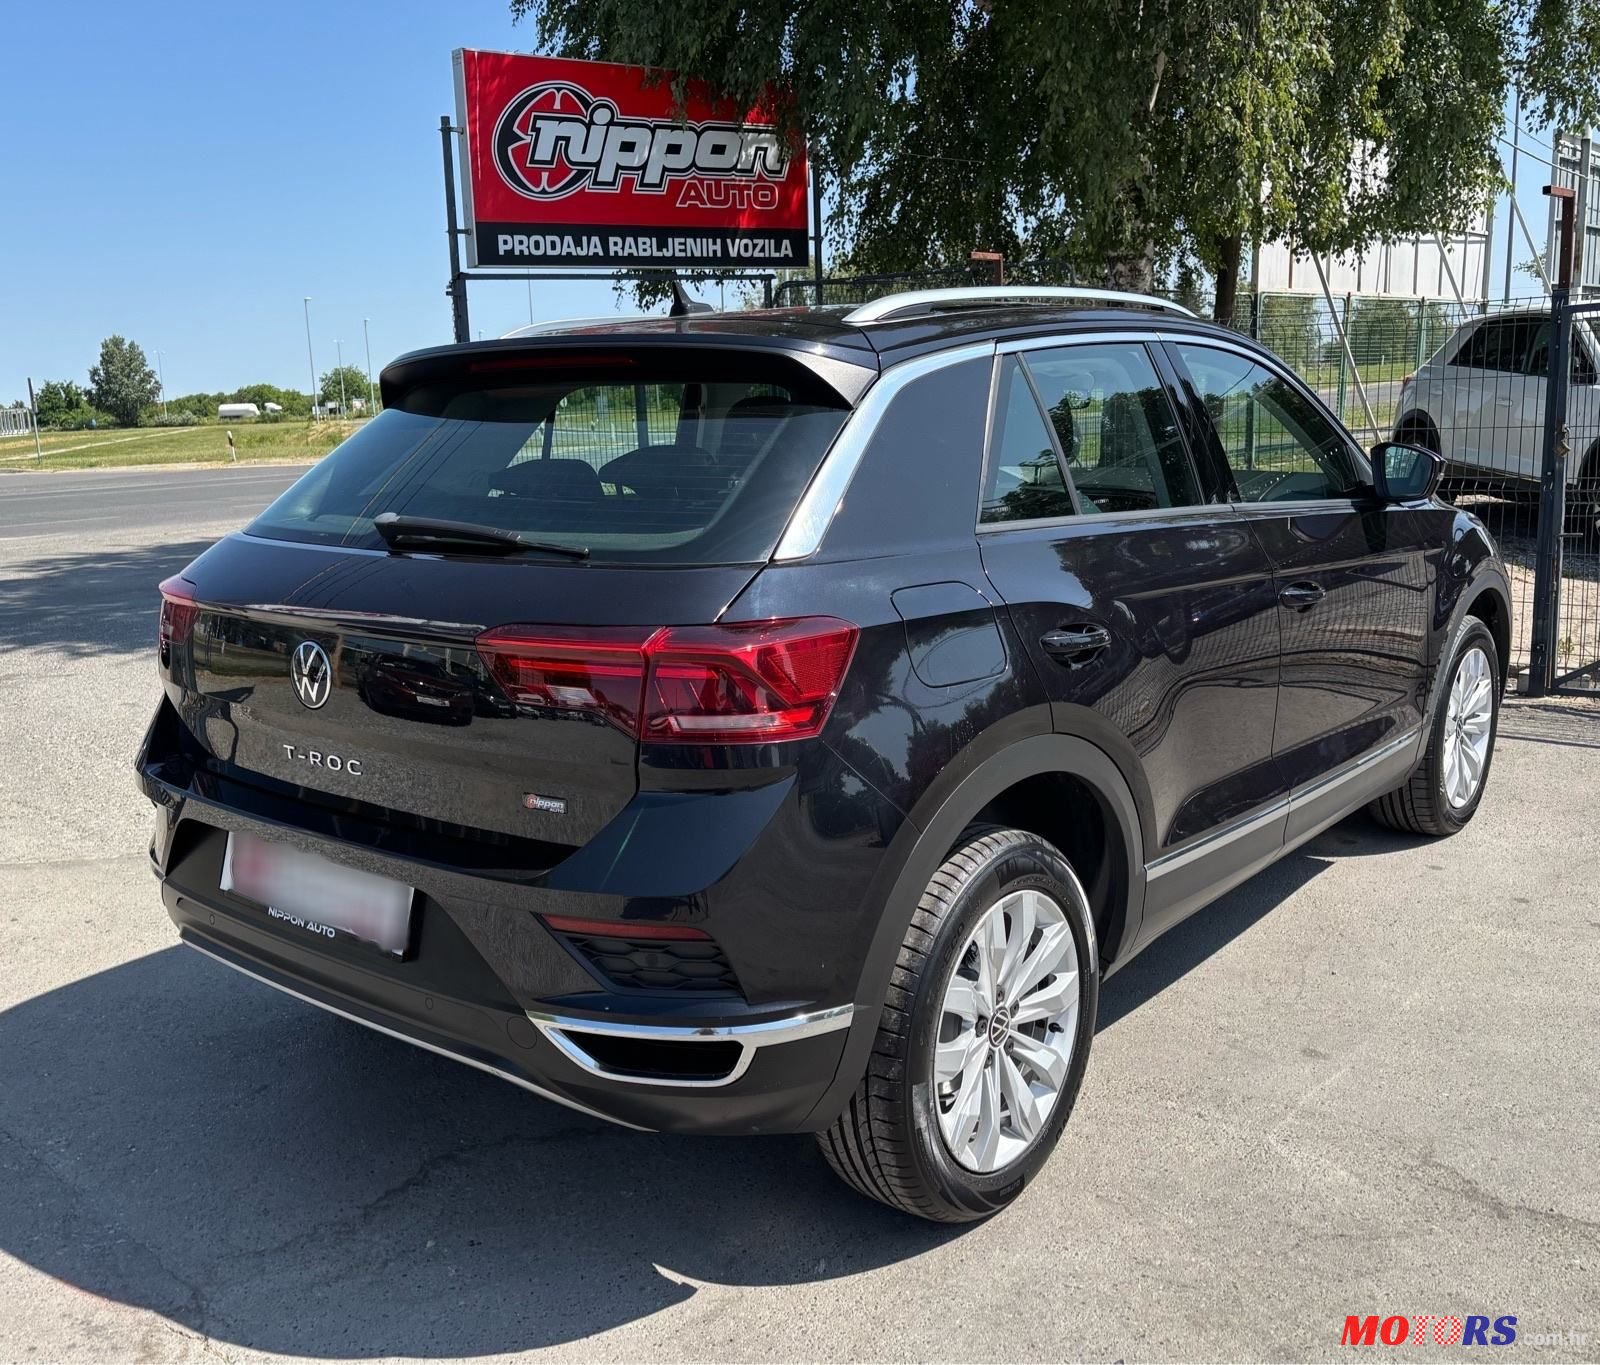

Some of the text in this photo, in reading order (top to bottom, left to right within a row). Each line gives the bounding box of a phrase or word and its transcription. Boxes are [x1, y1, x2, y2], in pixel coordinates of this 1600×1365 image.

[527, 98, 788, 191] nippon
[676, 180, 779, 210] AUTO
[497, 234, 794, 259] PRODAJA RABLJENIH VOZILA
[282, 743, 363, 777] T-ROC
[529, 795, 564, 809] nippon
[267, 905, 336, 938] NIPPON AUTO
